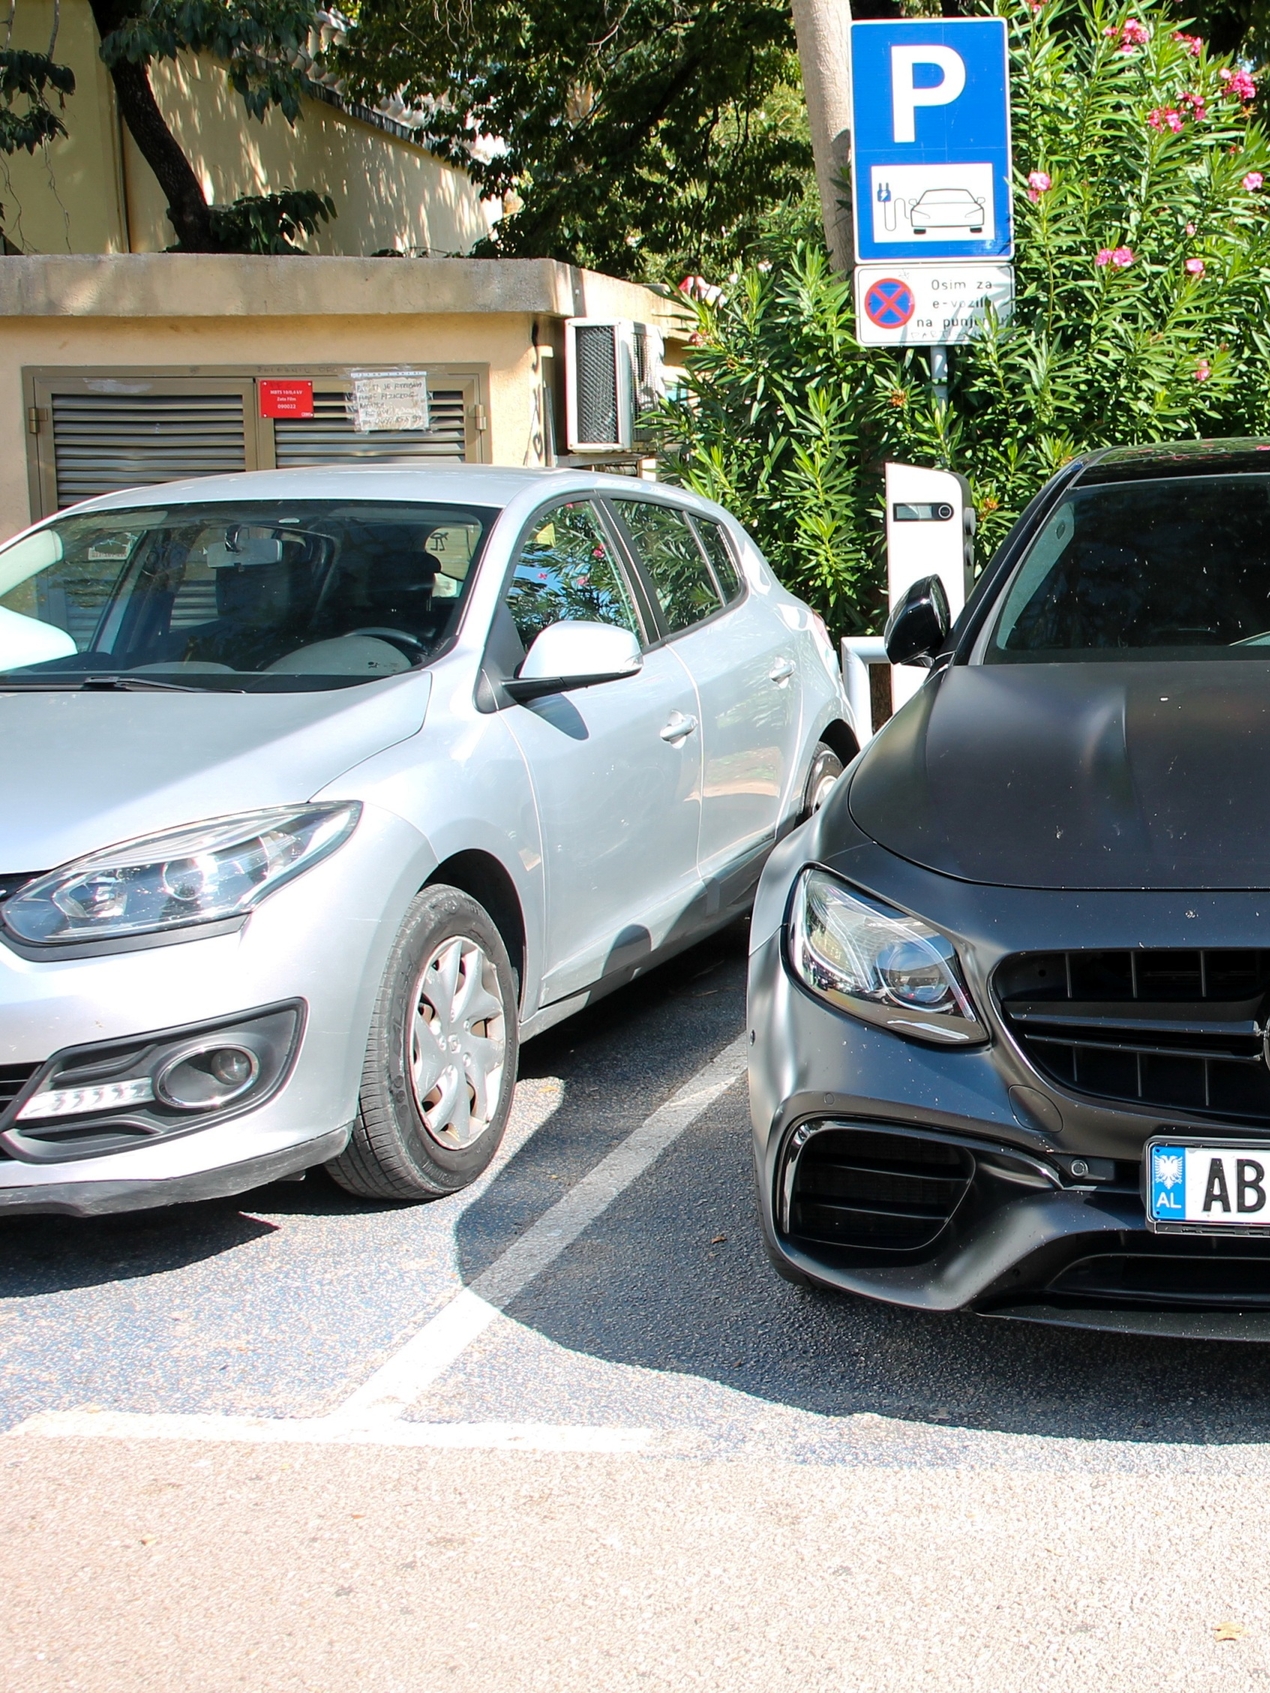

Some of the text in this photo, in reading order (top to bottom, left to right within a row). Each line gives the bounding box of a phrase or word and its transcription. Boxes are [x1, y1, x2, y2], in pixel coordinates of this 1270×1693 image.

[890, 44, 966, 143] P
[931, 278, 993, 291] Osim za
[916, 318, 933, 328] na
[1202, 1158, 1267, 1213] AB
[1156, 1191, 1182, 1208] AL
